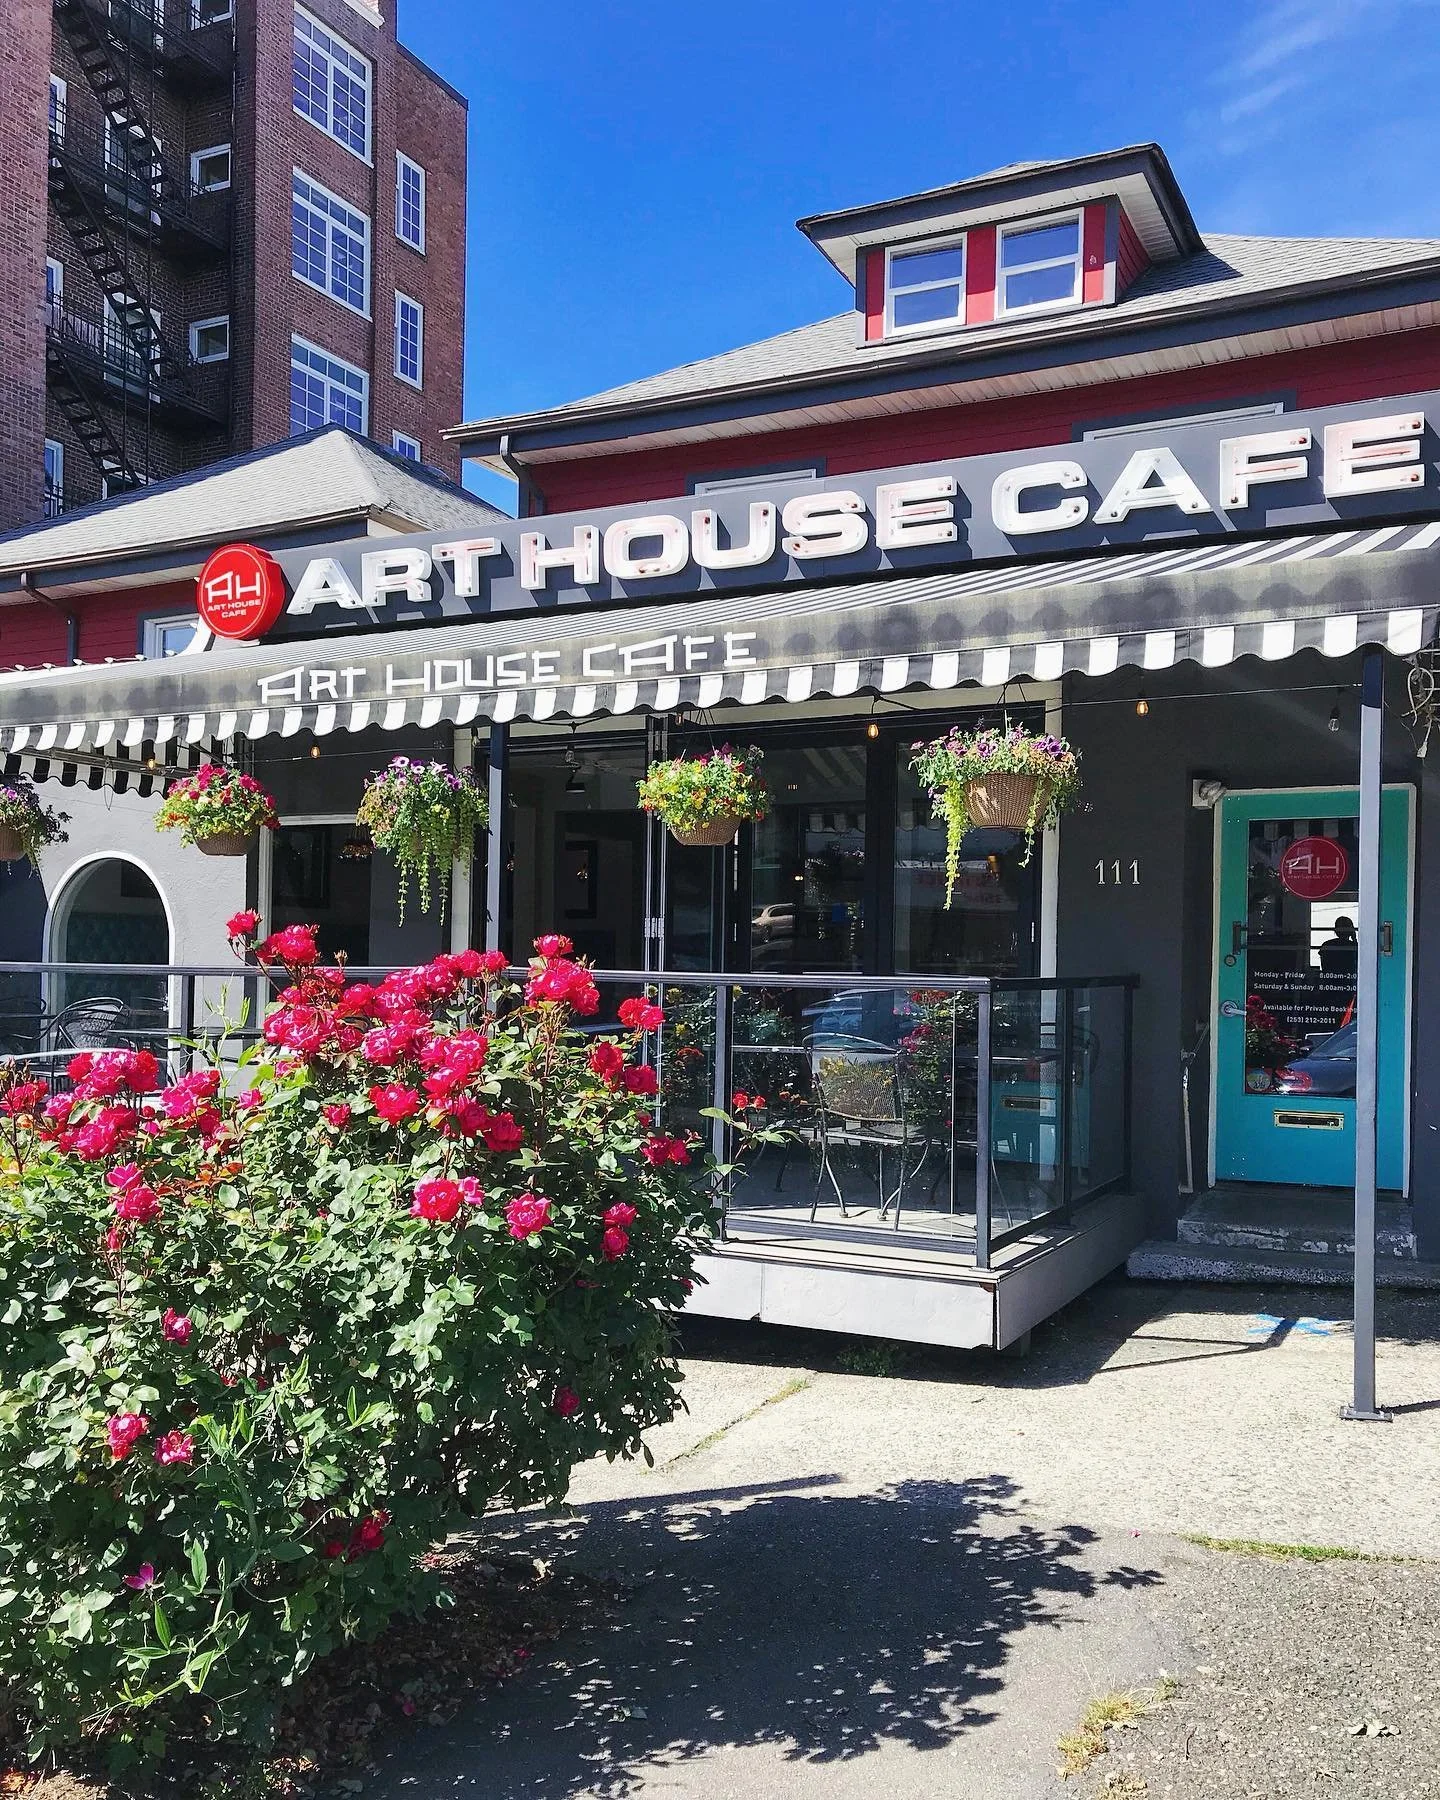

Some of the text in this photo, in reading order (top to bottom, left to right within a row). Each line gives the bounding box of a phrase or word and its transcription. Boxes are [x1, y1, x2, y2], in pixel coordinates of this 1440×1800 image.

[285, 412, 1425, 615] ART HOUSE CAFE
[207, 599, 261, 612] ART HOUSE
[221, 609, 247, 618] CAFE
[1095, 859, 1140, 885] 111
[1319, 972, 1357, 980] 8:00am-2:0
[1253, 982, 1283, 991] Saturday
[1290, 983, 1315, 992] Sunday
[1319, 984, 1357, 992] 8:00am-3:0
[1304, 1016, 1336, 1024] 212-2011
